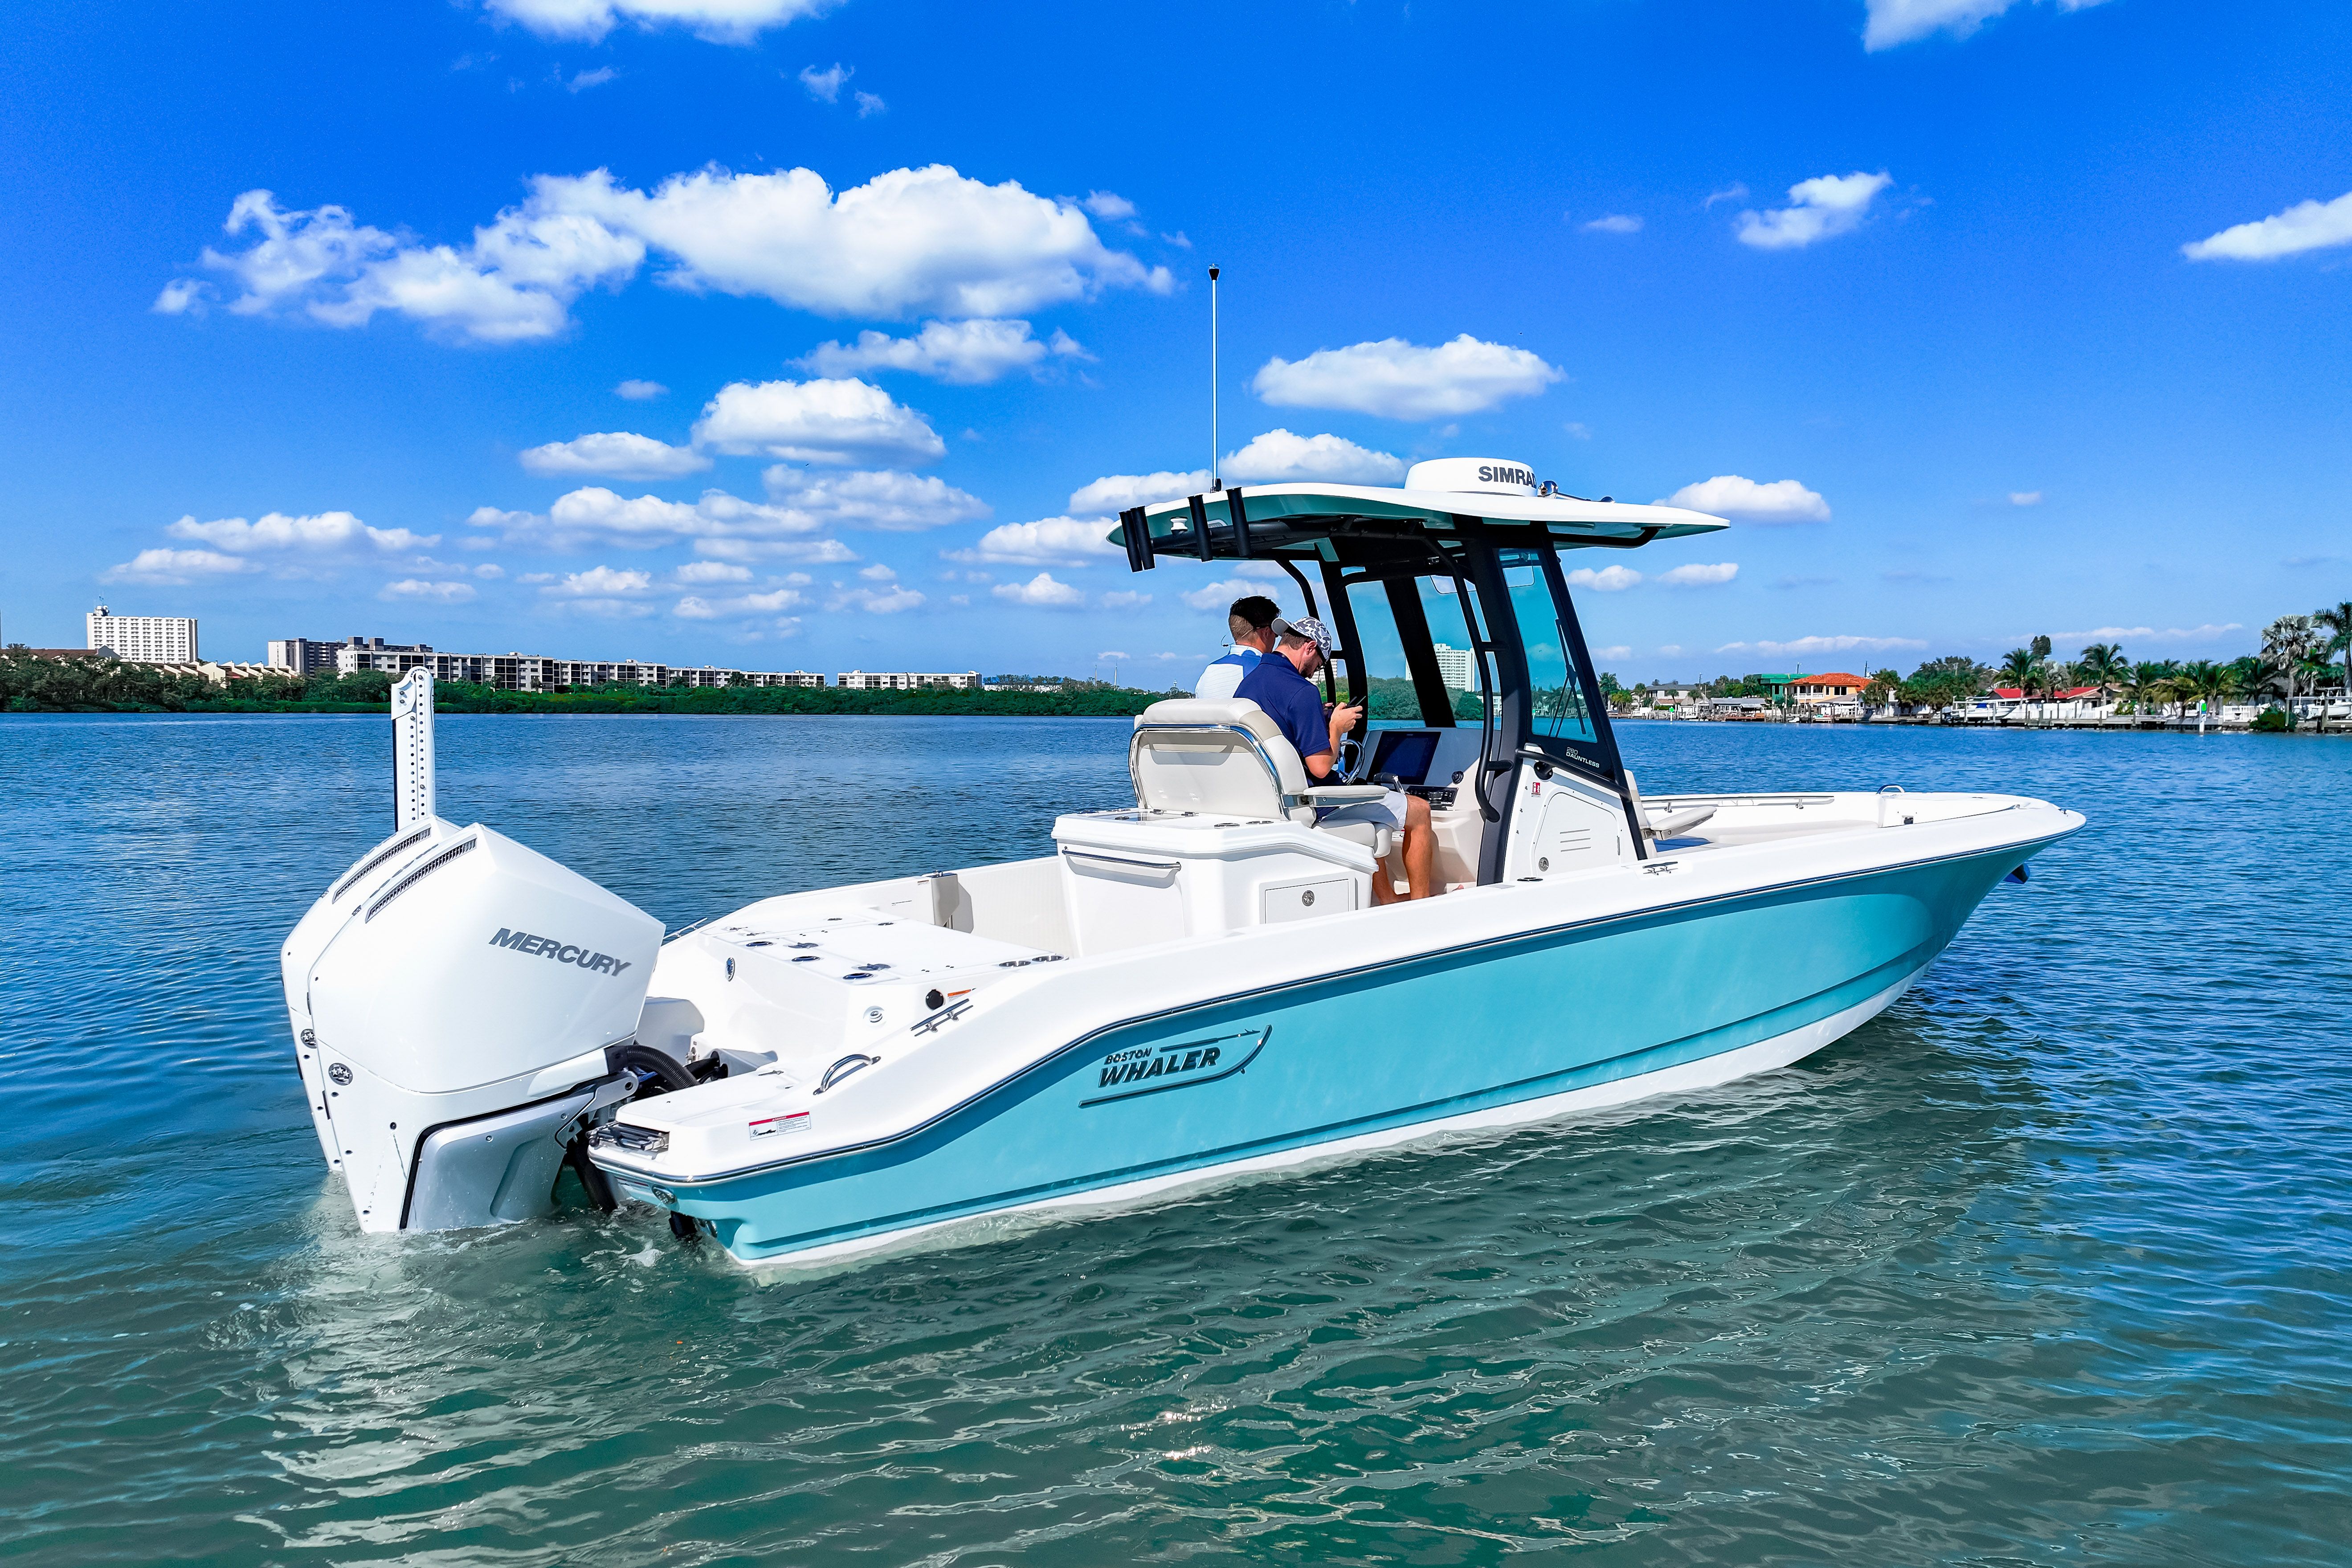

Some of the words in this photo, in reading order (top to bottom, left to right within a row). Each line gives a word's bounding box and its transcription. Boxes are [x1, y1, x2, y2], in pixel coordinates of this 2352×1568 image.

[1478, 466, 1537, 489] SIMRAD
[1566, 751, 1600, 768] DAUNTLESS
[1567, 747, 1578, 755] 280
[489, 927, 632, 977] MERCURY
[1103, 1046, 1152, 1065] BOSTON
[1098, 1046, 1221, 1088] WHALER
